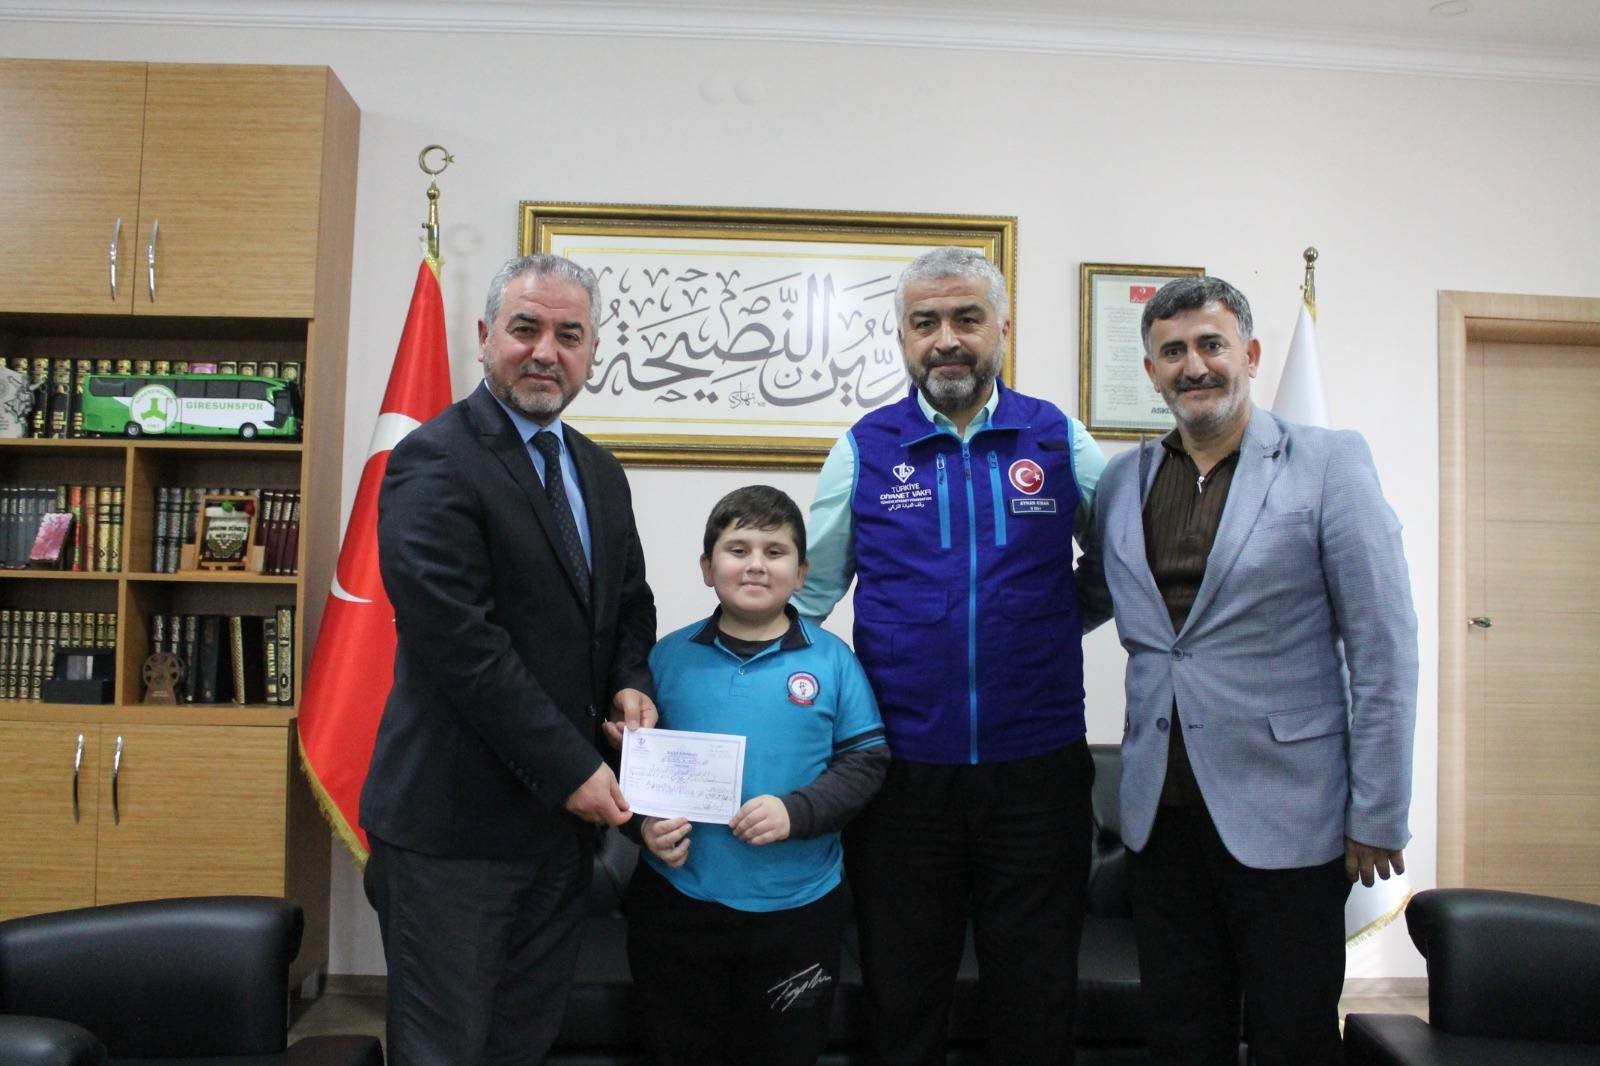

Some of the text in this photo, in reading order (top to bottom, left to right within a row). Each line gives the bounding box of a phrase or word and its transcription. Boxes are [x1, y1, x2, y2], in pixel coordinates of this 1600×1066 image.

[891, 483, 920, 493] TÜRKİYE
[880, 489, 932, 500] DİYANET VAKFI
